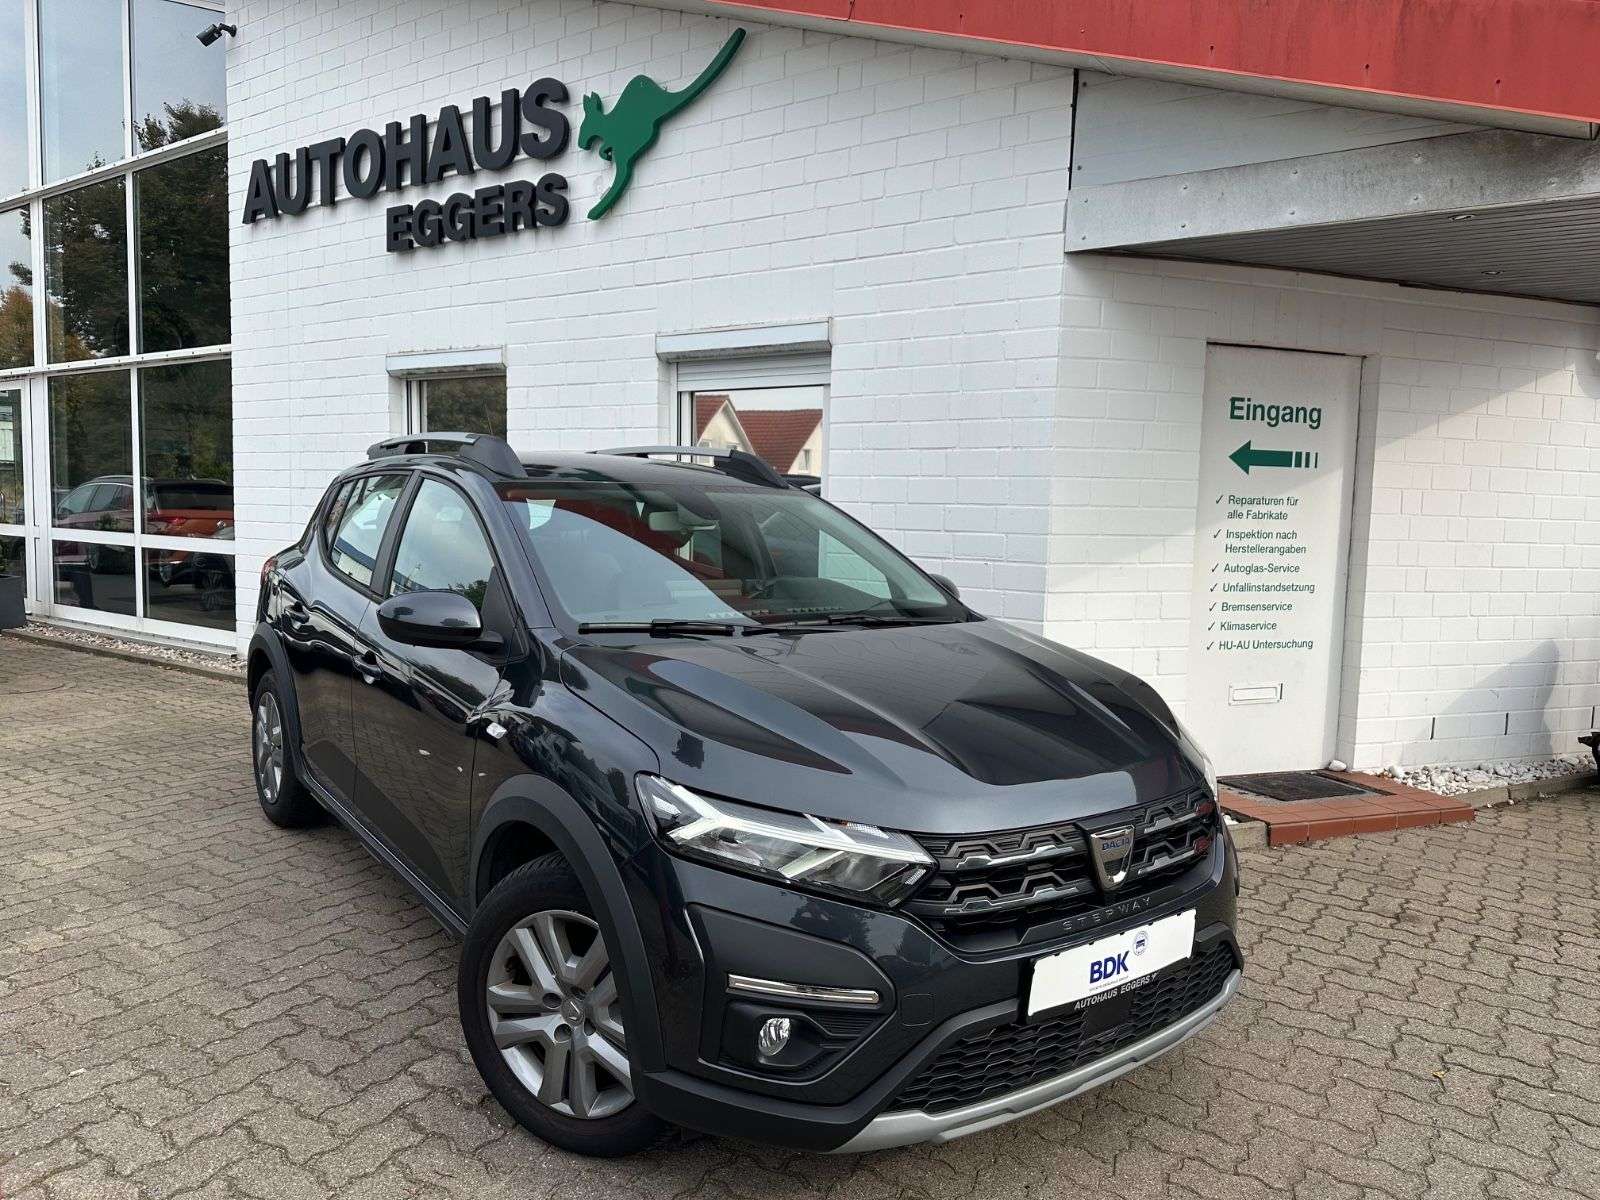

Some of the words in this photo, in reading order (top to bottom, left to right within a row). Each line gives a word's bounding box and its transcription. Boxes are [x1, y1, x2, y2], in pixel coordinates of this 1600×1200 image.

[243, 77, 570, 224] AUTOHAUS
[386, 172, 569, 252] EGGERS
[1229, 396, 1322, 430] Eingang
[1228, 494, 1284, 507] Reparaturen
[1286, 496, 1299, 506] für
[1227, 509, 1244, 519] alle
[1246, 509, 1288, 520] Fabrikate
[1226, 528, 1273, 540] Inspektion
[1275, 529, 1297, 540] nach
[1225, 543, 1307, 556] Herstellerangaben
[1223, 562, 1300, 574] Autoglas-Service
[1222, 582, 1315, 594] Unfallinstandsetzung
[1221, 601, 1293, 612] Bremsenservice
[1220, 620, 1278, 631] Klimaservice
[1218, 640, 1250, 650] HU-AU
[1252, 639, 1314, 650] Untersuchung
[1062, 897, 1150, 931] STEPWAY
[1089, 950, 1130, 984] BDK
[1074, 988, 1118, 1010] AUTOHAUS
[1120, 977, 1150, 994] EGGERS
